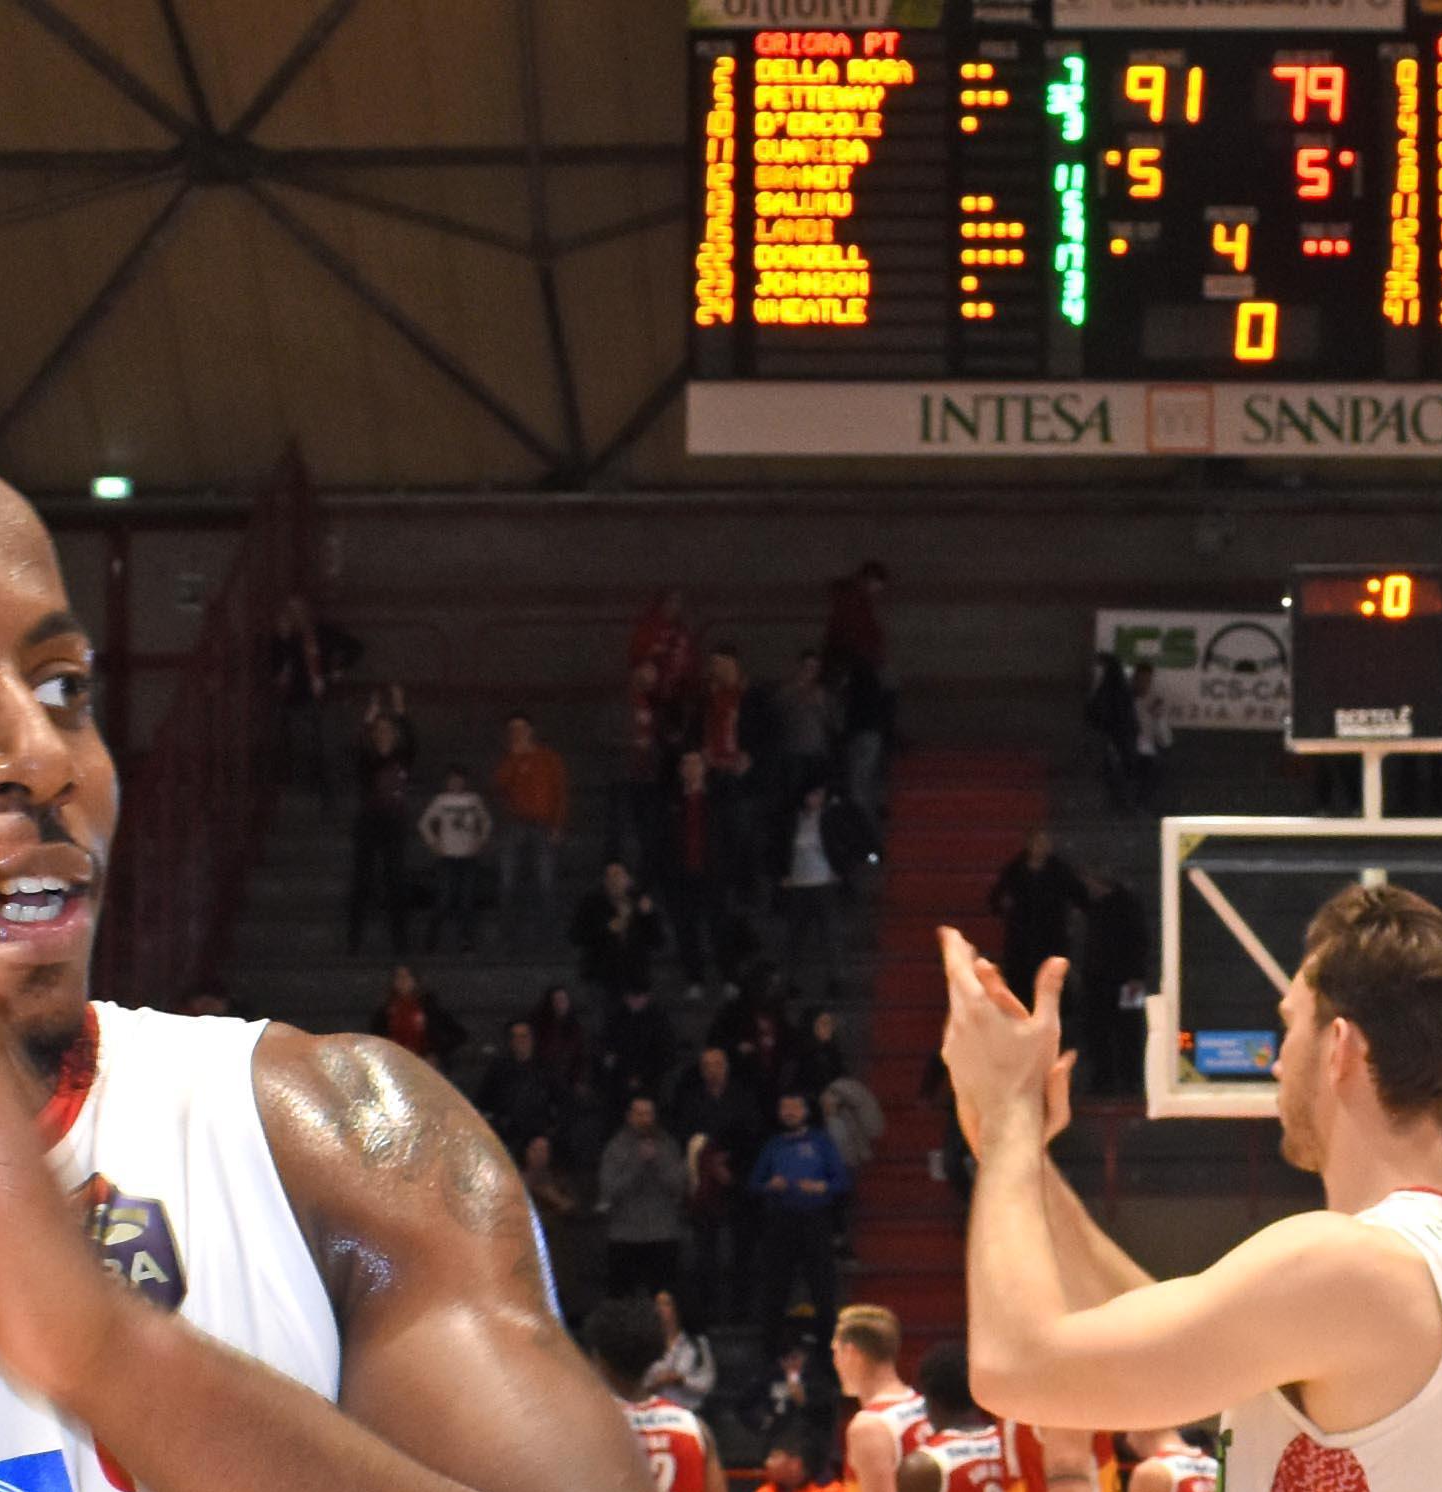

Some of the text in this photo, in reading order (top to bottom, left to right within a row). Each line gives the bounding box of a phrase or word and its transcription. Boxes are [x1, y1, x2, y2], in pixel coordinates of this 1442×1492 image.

[755, 32, 852, 56] ORIORA
[864, 32, 901, 55] PT
[755, 58, 839, 83] DELLA
[846, 58, 913, 83] ROSA
[1126, 66, 1203, 122] 91
[1272, 66, 1345, 122] 79
[755, 85, 885, 110] PETTEWAY
[707, 138, 734, 164] 11
[1128, 148, 1162, 197] 5
[1296, 148, 1330, 198] 5
[1392, 192, 1419, 218] 11
[1213, 223, 1249, 271] 4
[1234, 302, 1277, 360] 0
[920, 393, 1114, 444] INTESA
